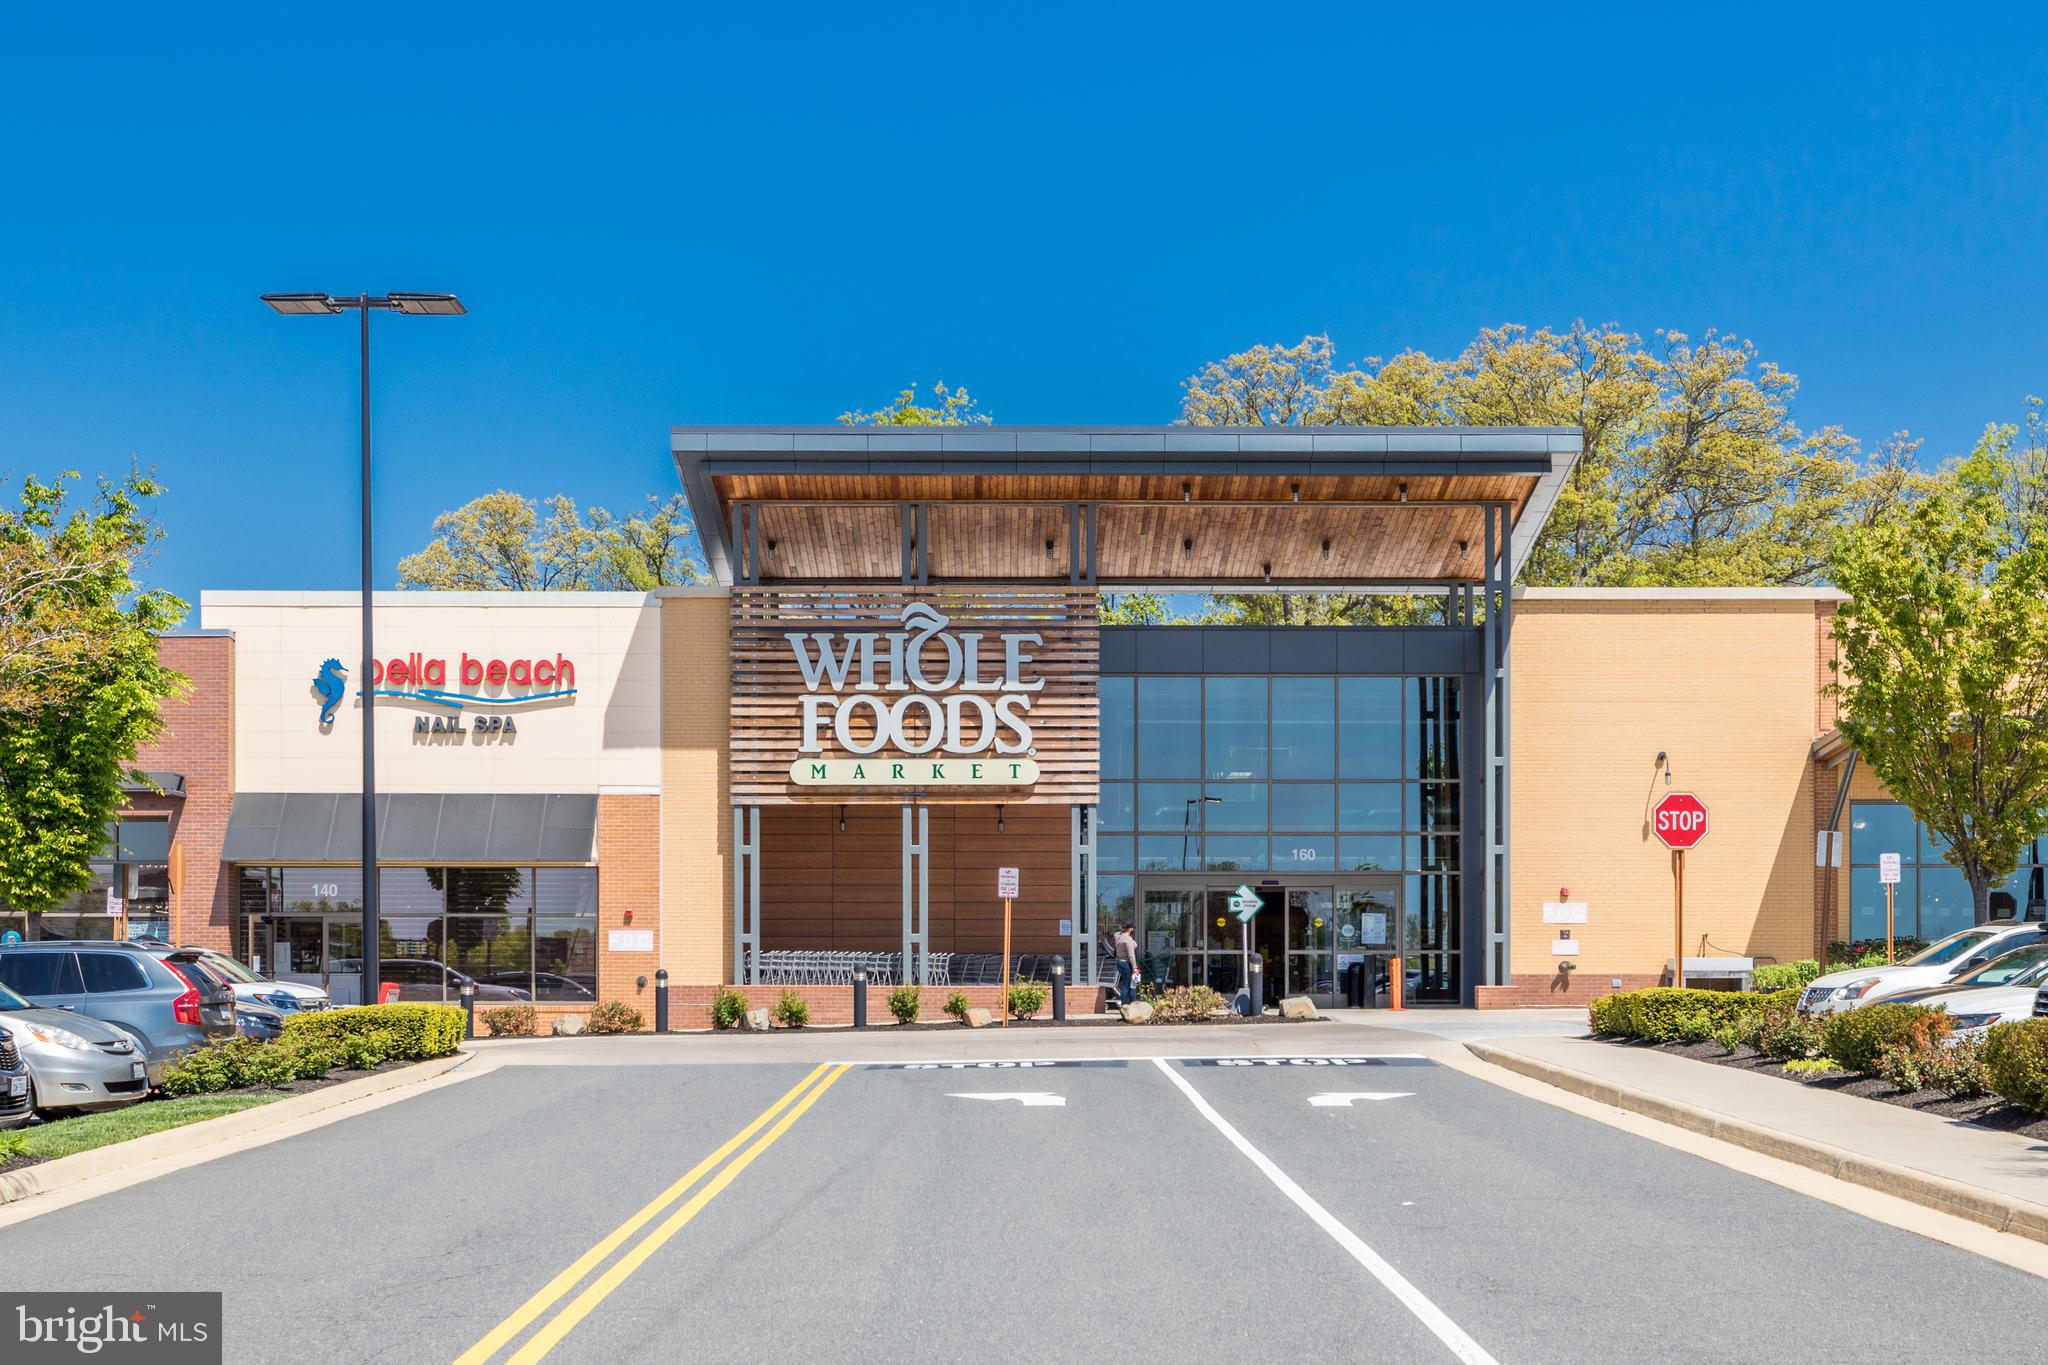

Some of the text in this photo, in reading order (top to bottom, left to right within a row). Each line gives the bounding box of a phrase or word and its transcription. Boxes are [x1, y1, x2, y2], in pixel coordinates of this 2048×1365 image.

[784, 602, 1046, 692] WHOLE
[461, 653, 575, 686] beach
[414, 716, 517, 733] NAIL SPA
[798, 694, 1033, 754] FOODS
[811, 763, 1022, 780] MARKET
[1658, 810, 1704, 831] STOP
[1292, 848, 1316, 861] 160
[312, 883, 338, 897] 140
